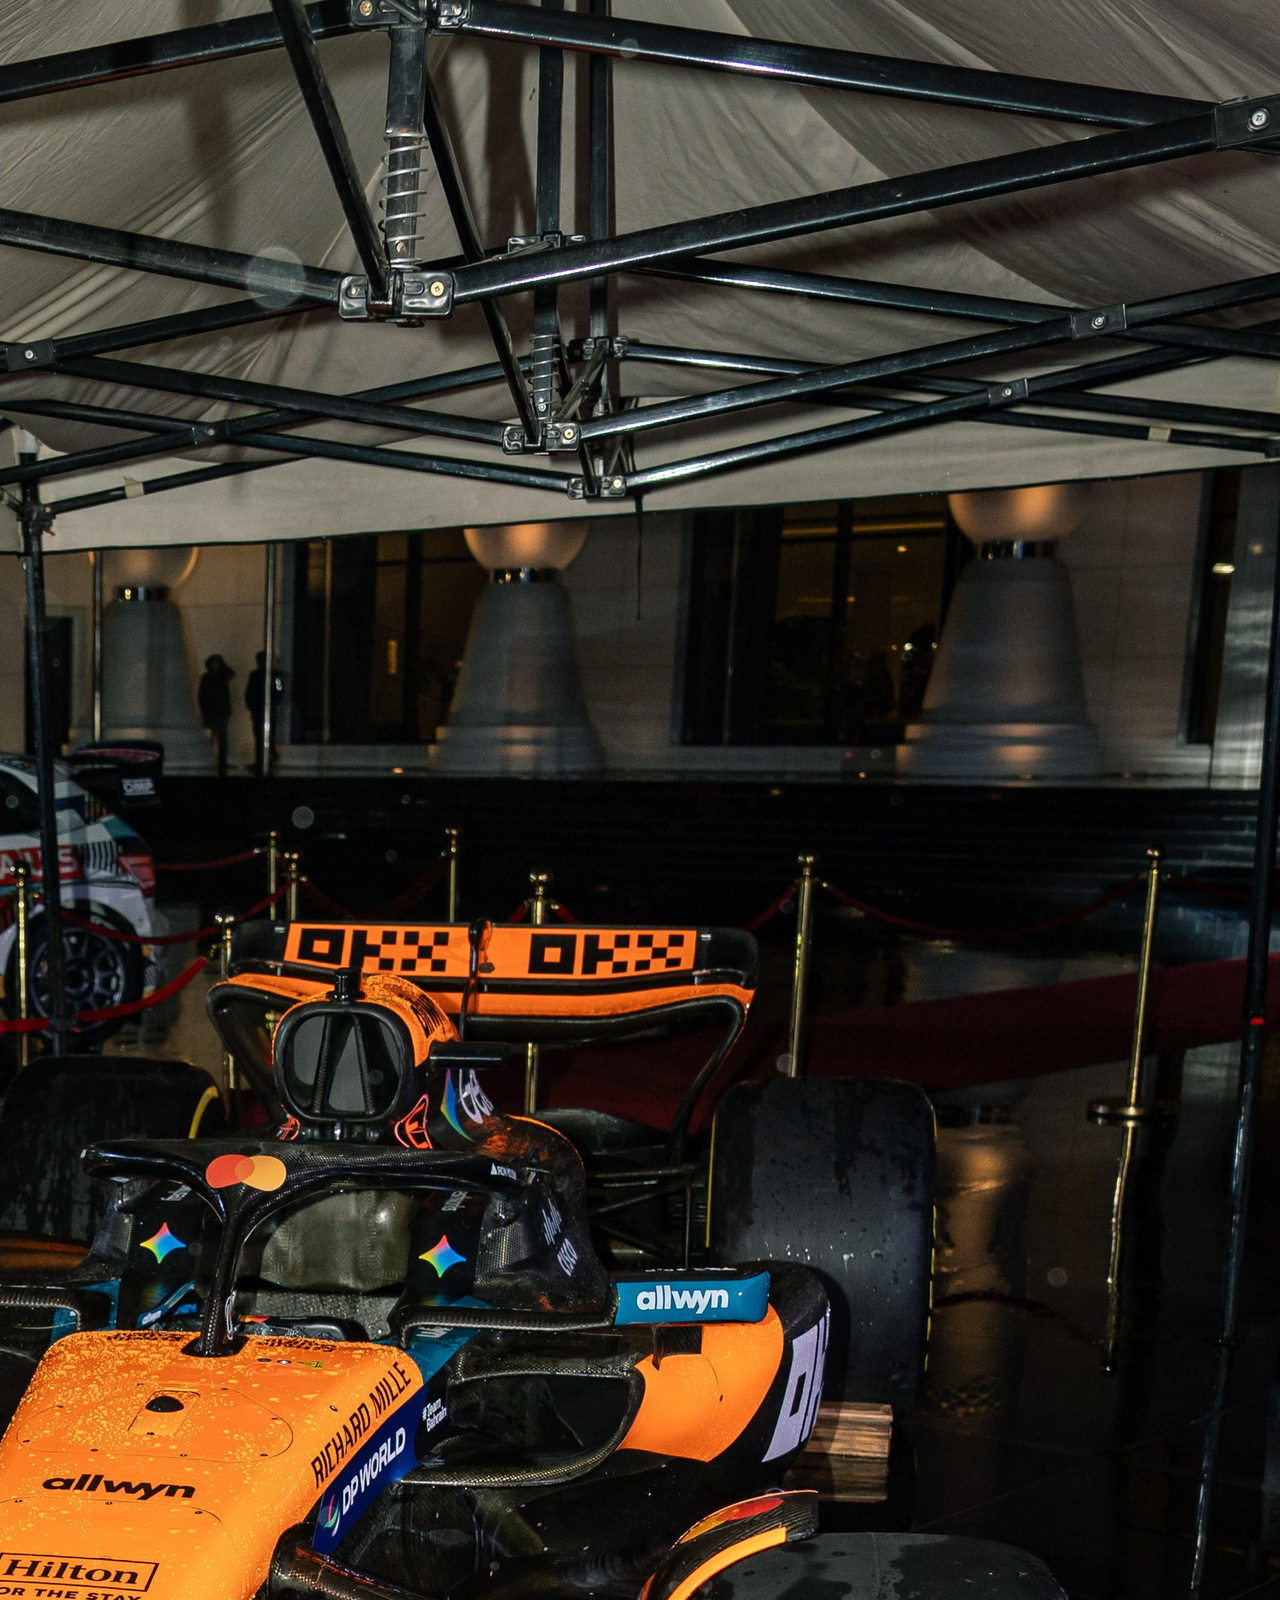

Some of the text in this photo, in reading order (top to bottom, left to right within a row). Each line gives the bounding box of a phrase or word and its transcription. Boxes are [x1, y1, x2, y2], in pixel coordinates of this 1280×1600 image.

[636, 1284, 729, 1315] allwyn
[422, 1397, 442, 1421] #Team
[426, 1405, 448, 1433] Bahrain
[310, 1361, 412, 1490] RICHARD MILLE
[342, 1426, 407, 1516] DP WORLD
[41, 1473, 197, 1501] allwyn
[1, 1558, 140, 1585] Hilton
[34, 1587, 79, 1600] THE
